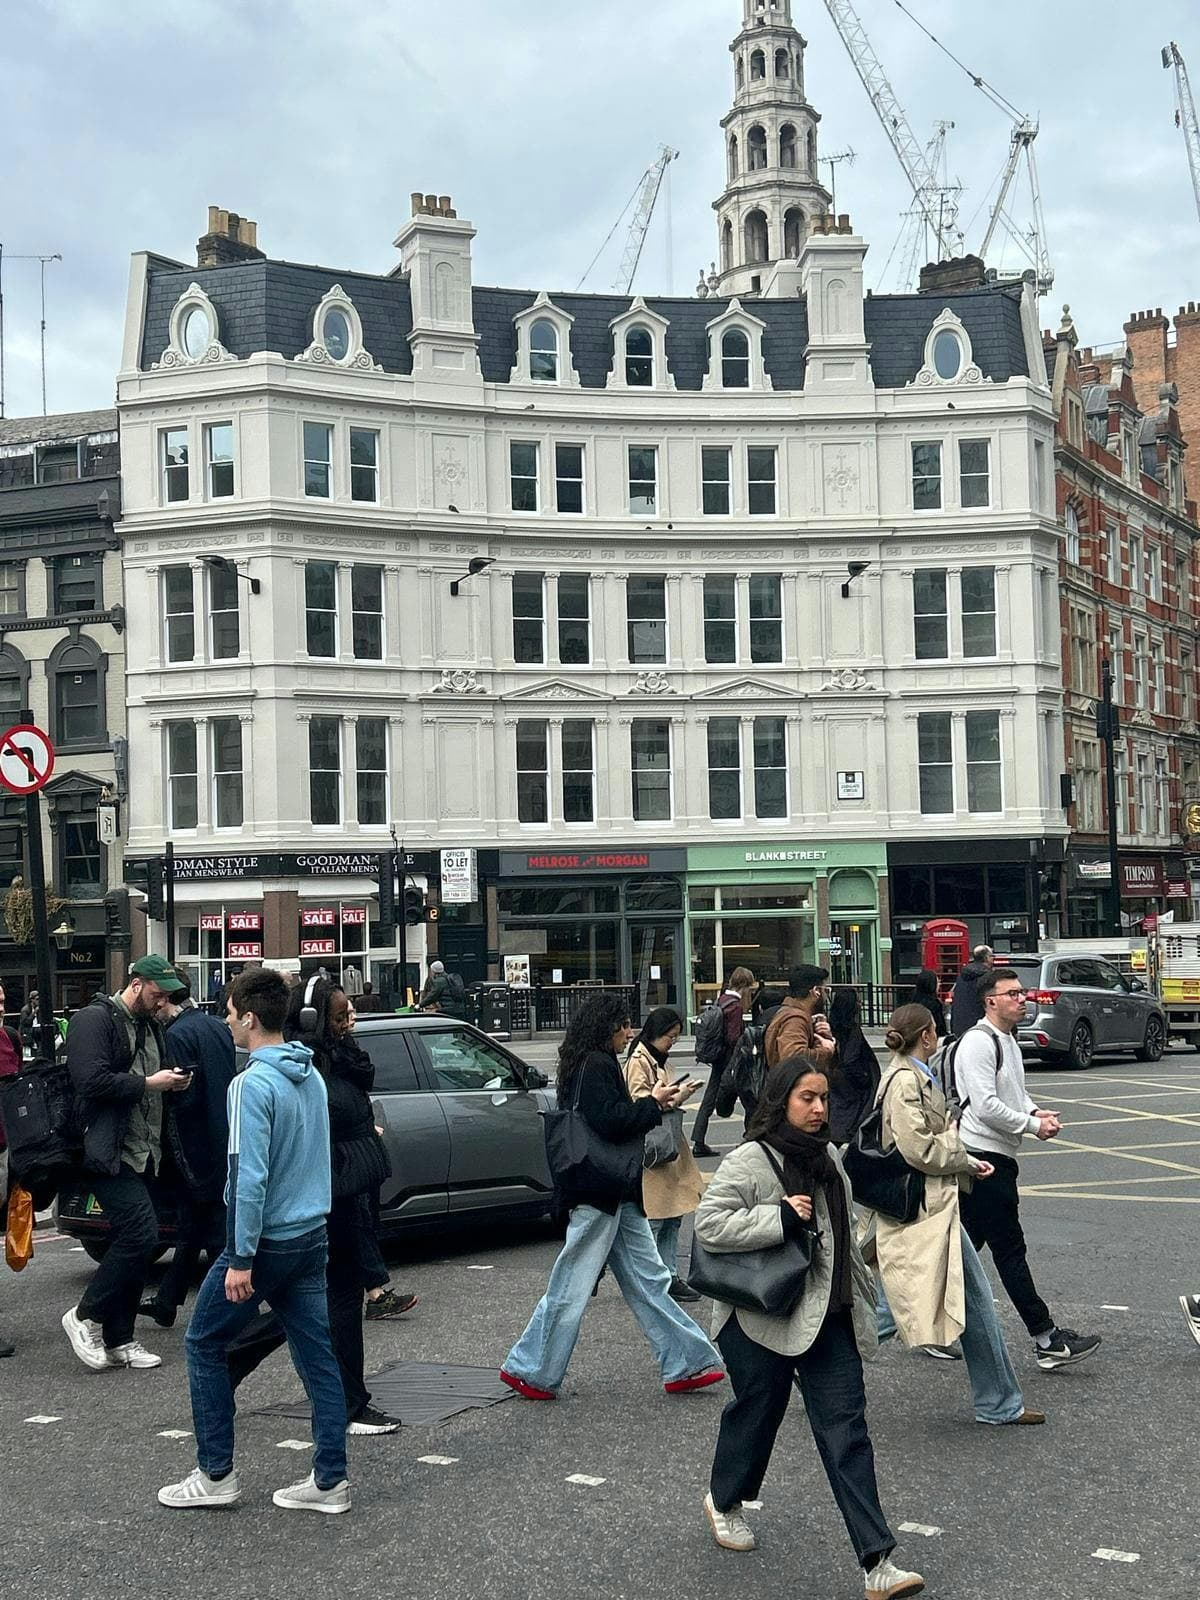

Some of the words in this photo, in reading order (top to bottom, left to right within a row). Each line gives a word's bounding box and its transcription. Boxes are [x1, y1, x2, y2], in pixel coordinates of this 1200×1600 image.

[296, 854, 370, 866] GOODMAN
[529, 855, 579, 868] MELROSE
[595, 854, 649, 866] MORGAN
[745, 851, 780, 862] BLANK
[786, 850, 828, 861] STREET
[173, 859, 213, 870] DMAN
[217, 857, 258, 868] STYLE
[443, 858, 454, 868] TO
[456, 857, 469, 868] LET
[194, 867, 245, 877] MENSWEAR
[311, 865, 348, 874] ITALIAN
[1123, 865, 1156, 881] TIMPSON
[231, 918, 259, 929] SALE
[303, 914, 334, 925] SALE
[342, 912, 366, 924] SALE
[201, 919, 223, 930] SALE
[230, 945, 259, 956] SALE
[303, 942, 334, 953] SALE
[70, 951, 93, 963] No.2
